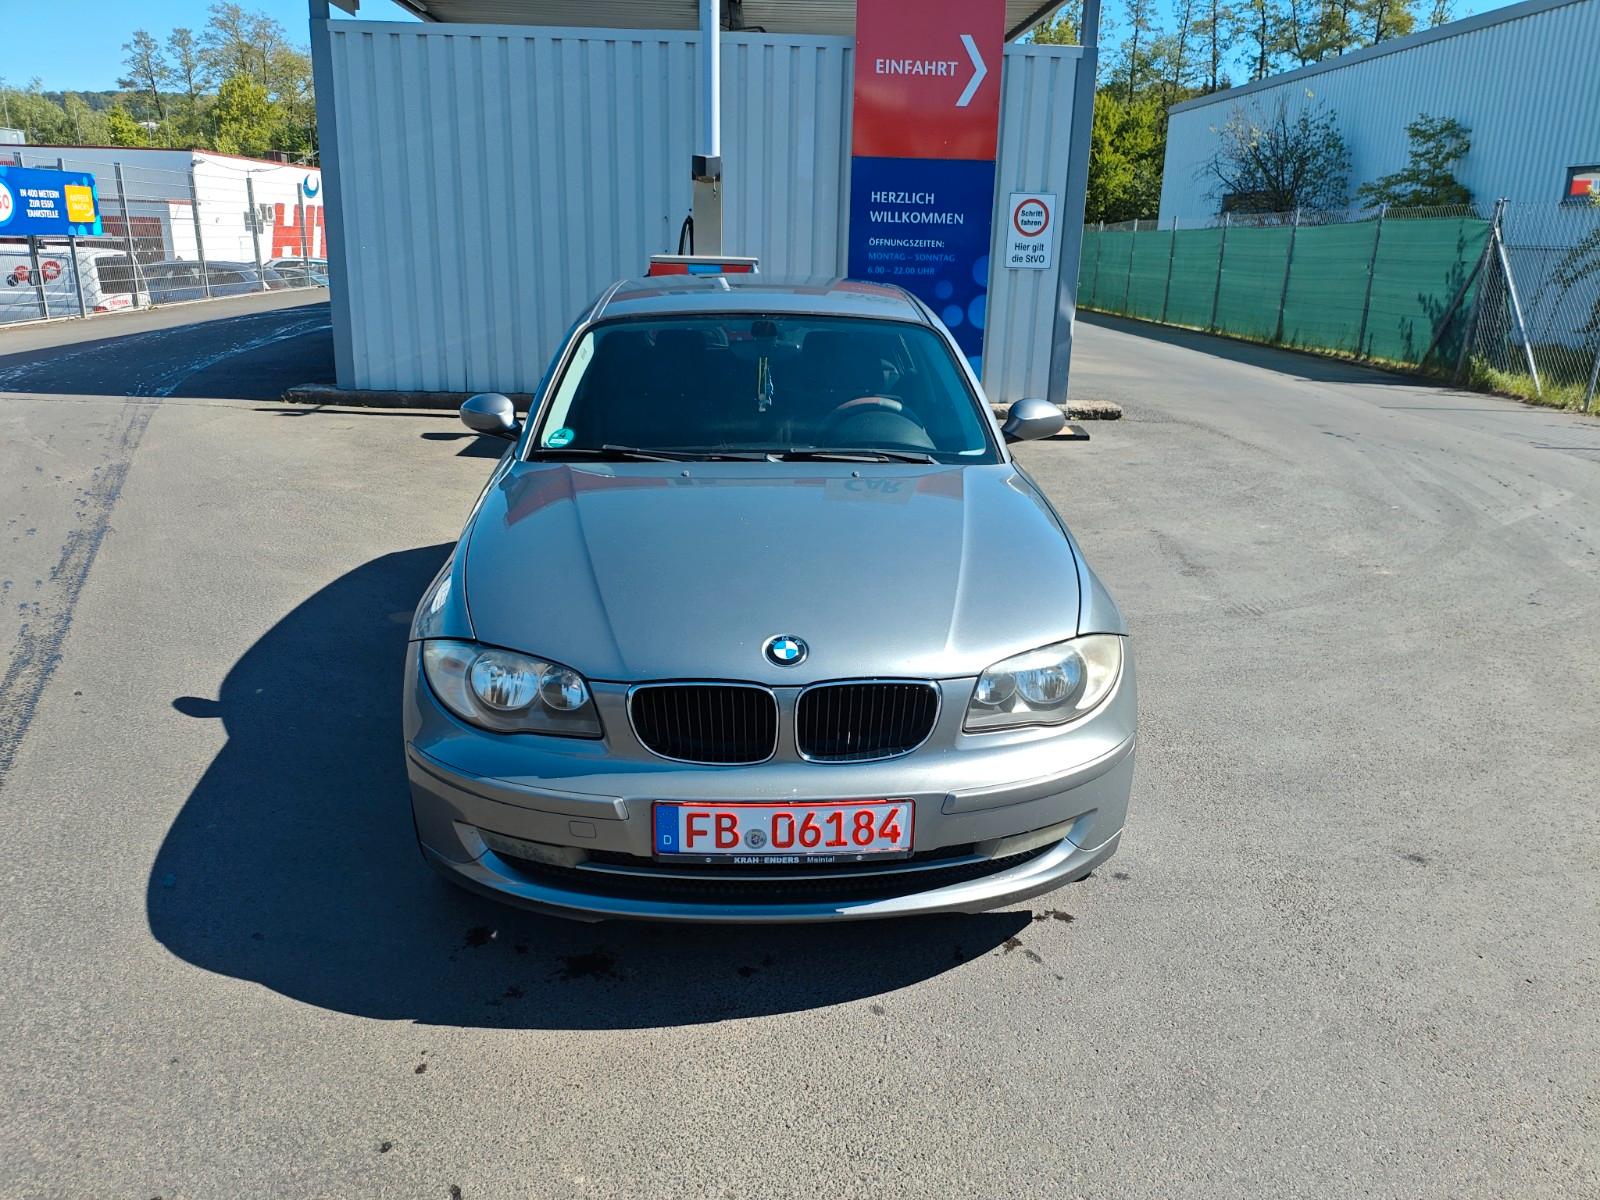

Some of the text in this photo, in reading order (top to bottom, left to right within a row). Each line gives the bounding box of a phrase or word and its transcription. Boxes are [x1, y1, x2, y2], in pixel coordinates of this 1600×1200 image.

[875, 58, 959, 76] EINFAHRT
[28, 189, 38, 198] 400
[871, 191, 935, 205] HERZLICH
[26, 209, 59, 218] TANKSTELLE
[869, 210, 964, 225] WILLKOMMEN
[1020, 209, 1043, 217] Schritt
[1020, 219, 1042, 227] fahren
[868, 236, 945, 248] ÖFFNUNGSZEITEN:
[1014, 241, 1044, 253] Hier gilt
[868, 252, 906, 261] MONTAG
[914, 253, 956, 263] SONNTAG
[1011, 254, 1045, 264] die StVO
[917, 267, 936, 276] UHR
[685, 808, 902, 849] FB 06184
[663, 834, 672, 845] D
[764, 856, 800, 864] ENDERS
